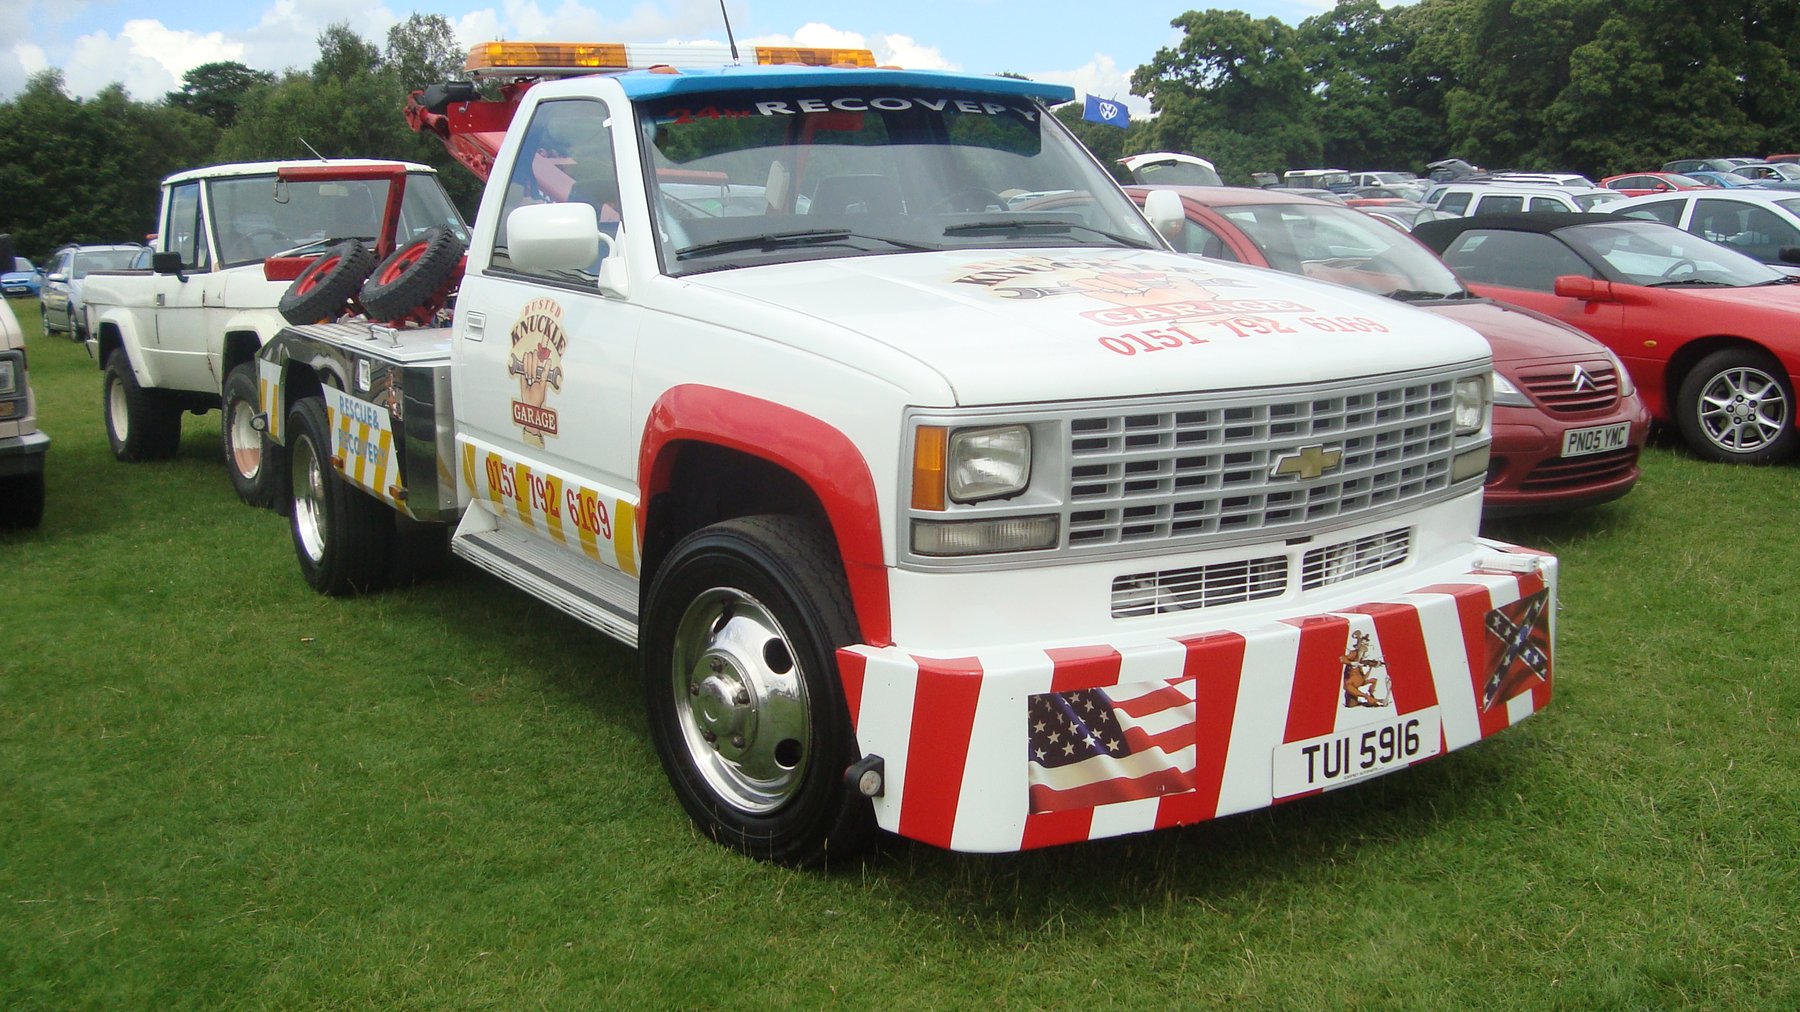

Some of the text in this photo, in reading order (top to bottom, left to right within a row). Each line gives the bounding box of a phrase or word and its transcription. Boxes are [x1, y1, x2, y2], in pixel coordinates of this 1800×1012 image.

[755, 97, 1037, 122] RECOVERY
[524, 299, 561, 318] BUSTED
[1100, 299, 1300, 324] GARAGE
[511, 314, 567, 358] KNUCKLE
[1098, 315, 1390, 356] 0151 792 6169
[513, 404, 557, 431] GARAGE
[1568, 426, 1625, 453] PN05 YMC
[485, 456, 612, 540] 0151 792 6169
[1302, 718, 1420, 784] TUI 5916
